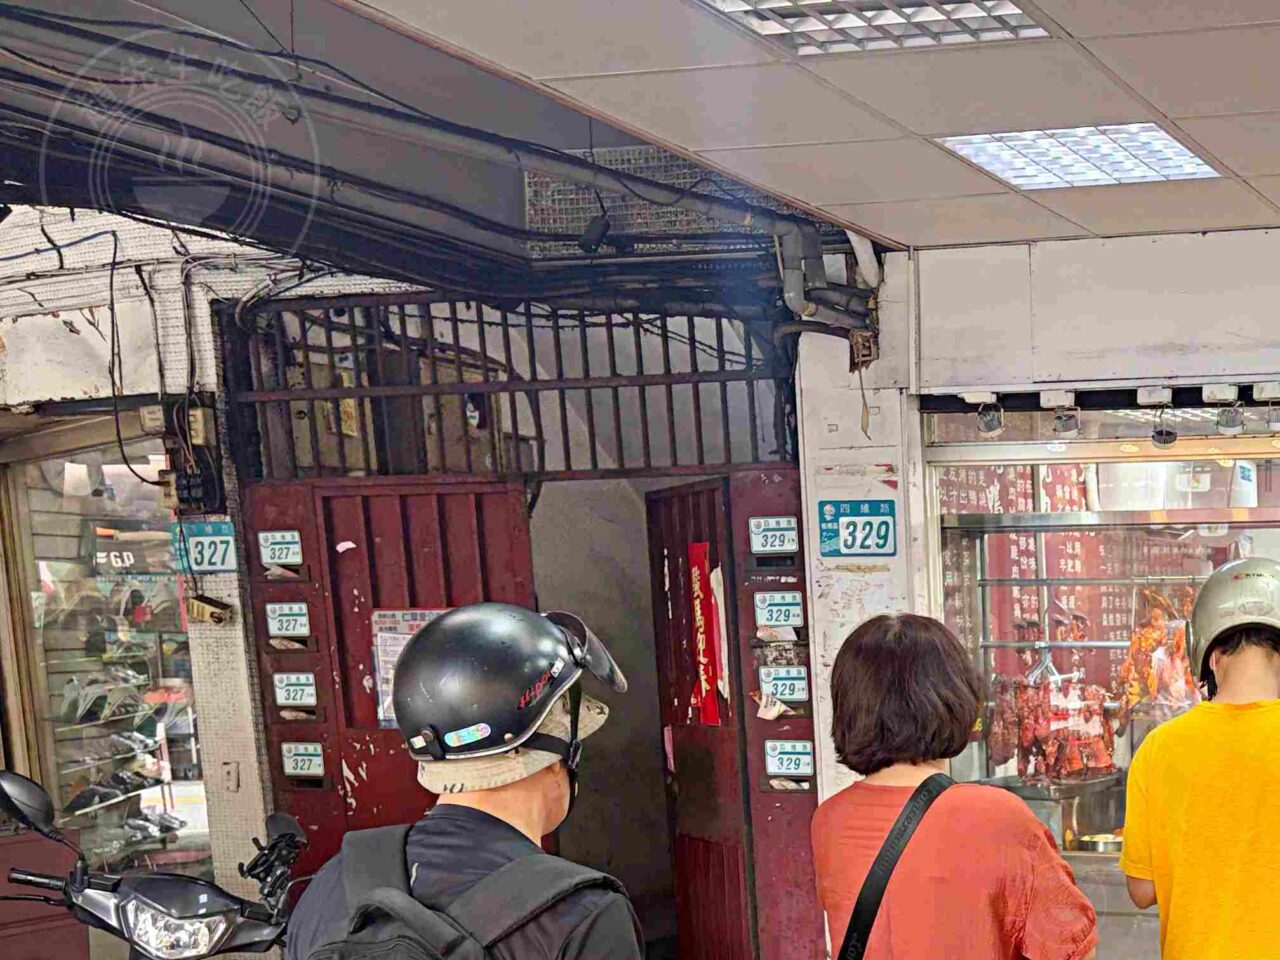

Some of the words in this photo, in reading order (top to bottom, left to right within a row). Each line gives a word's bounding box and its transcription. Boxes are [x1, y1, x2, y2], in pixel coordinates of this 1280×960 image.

[761, 533, 786, 547] 329
[843, 520, 890, 549] 329
[194, 540, 231, 566] 327
[269, 547, 291, 560] 327
[766, 608, 791, 622] 329
[277, 619, 298, 632] 327
[284, 689, 306, 701] 327
[771, 682, 796, 697] 329
[292, 758, 313, 771] 327
[777, 757, 801, 770] 329
